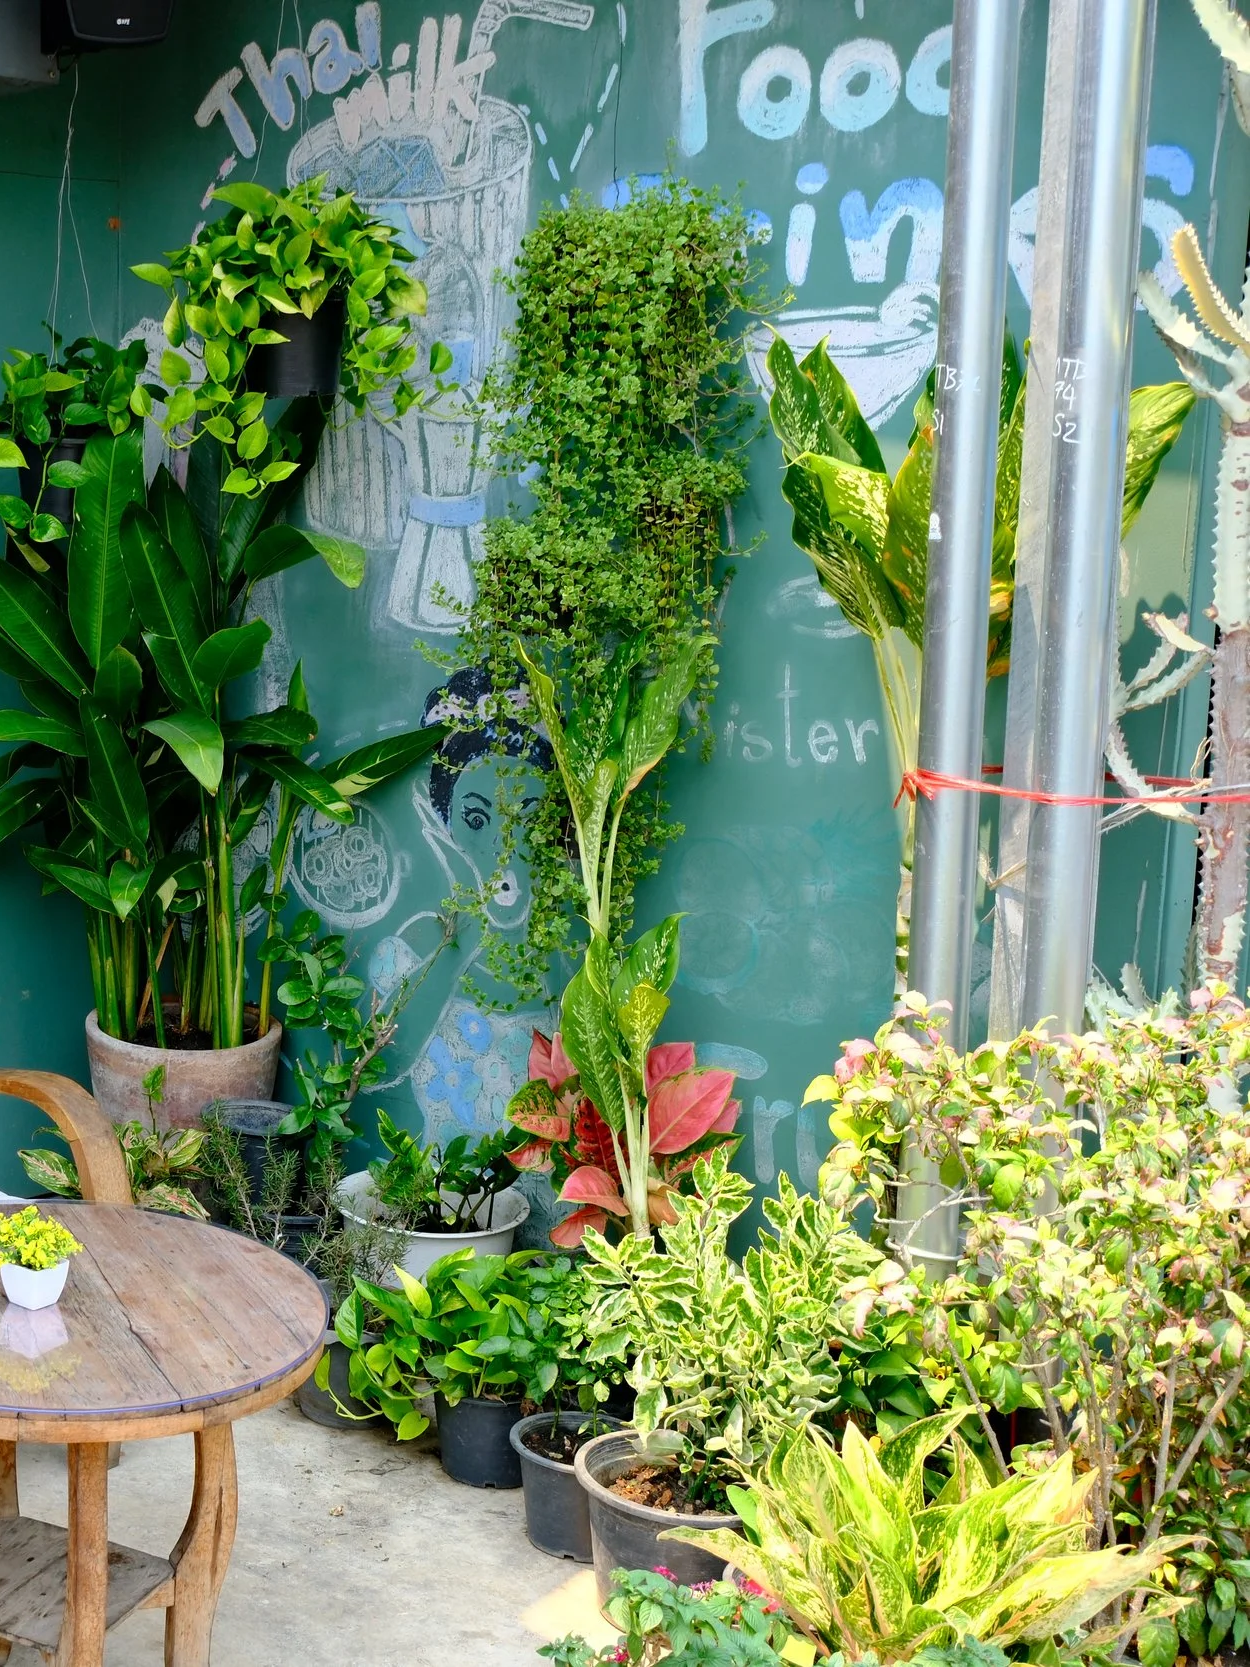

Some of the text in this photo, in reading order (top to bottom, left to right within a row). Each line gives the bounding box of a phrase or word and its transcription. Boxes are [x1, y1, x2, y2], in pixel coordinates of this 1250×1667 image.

[332, 13, 497, 150] milk
[1054, 380, 1077, 411] 74
[1052, 413, 1082, 444] S2
